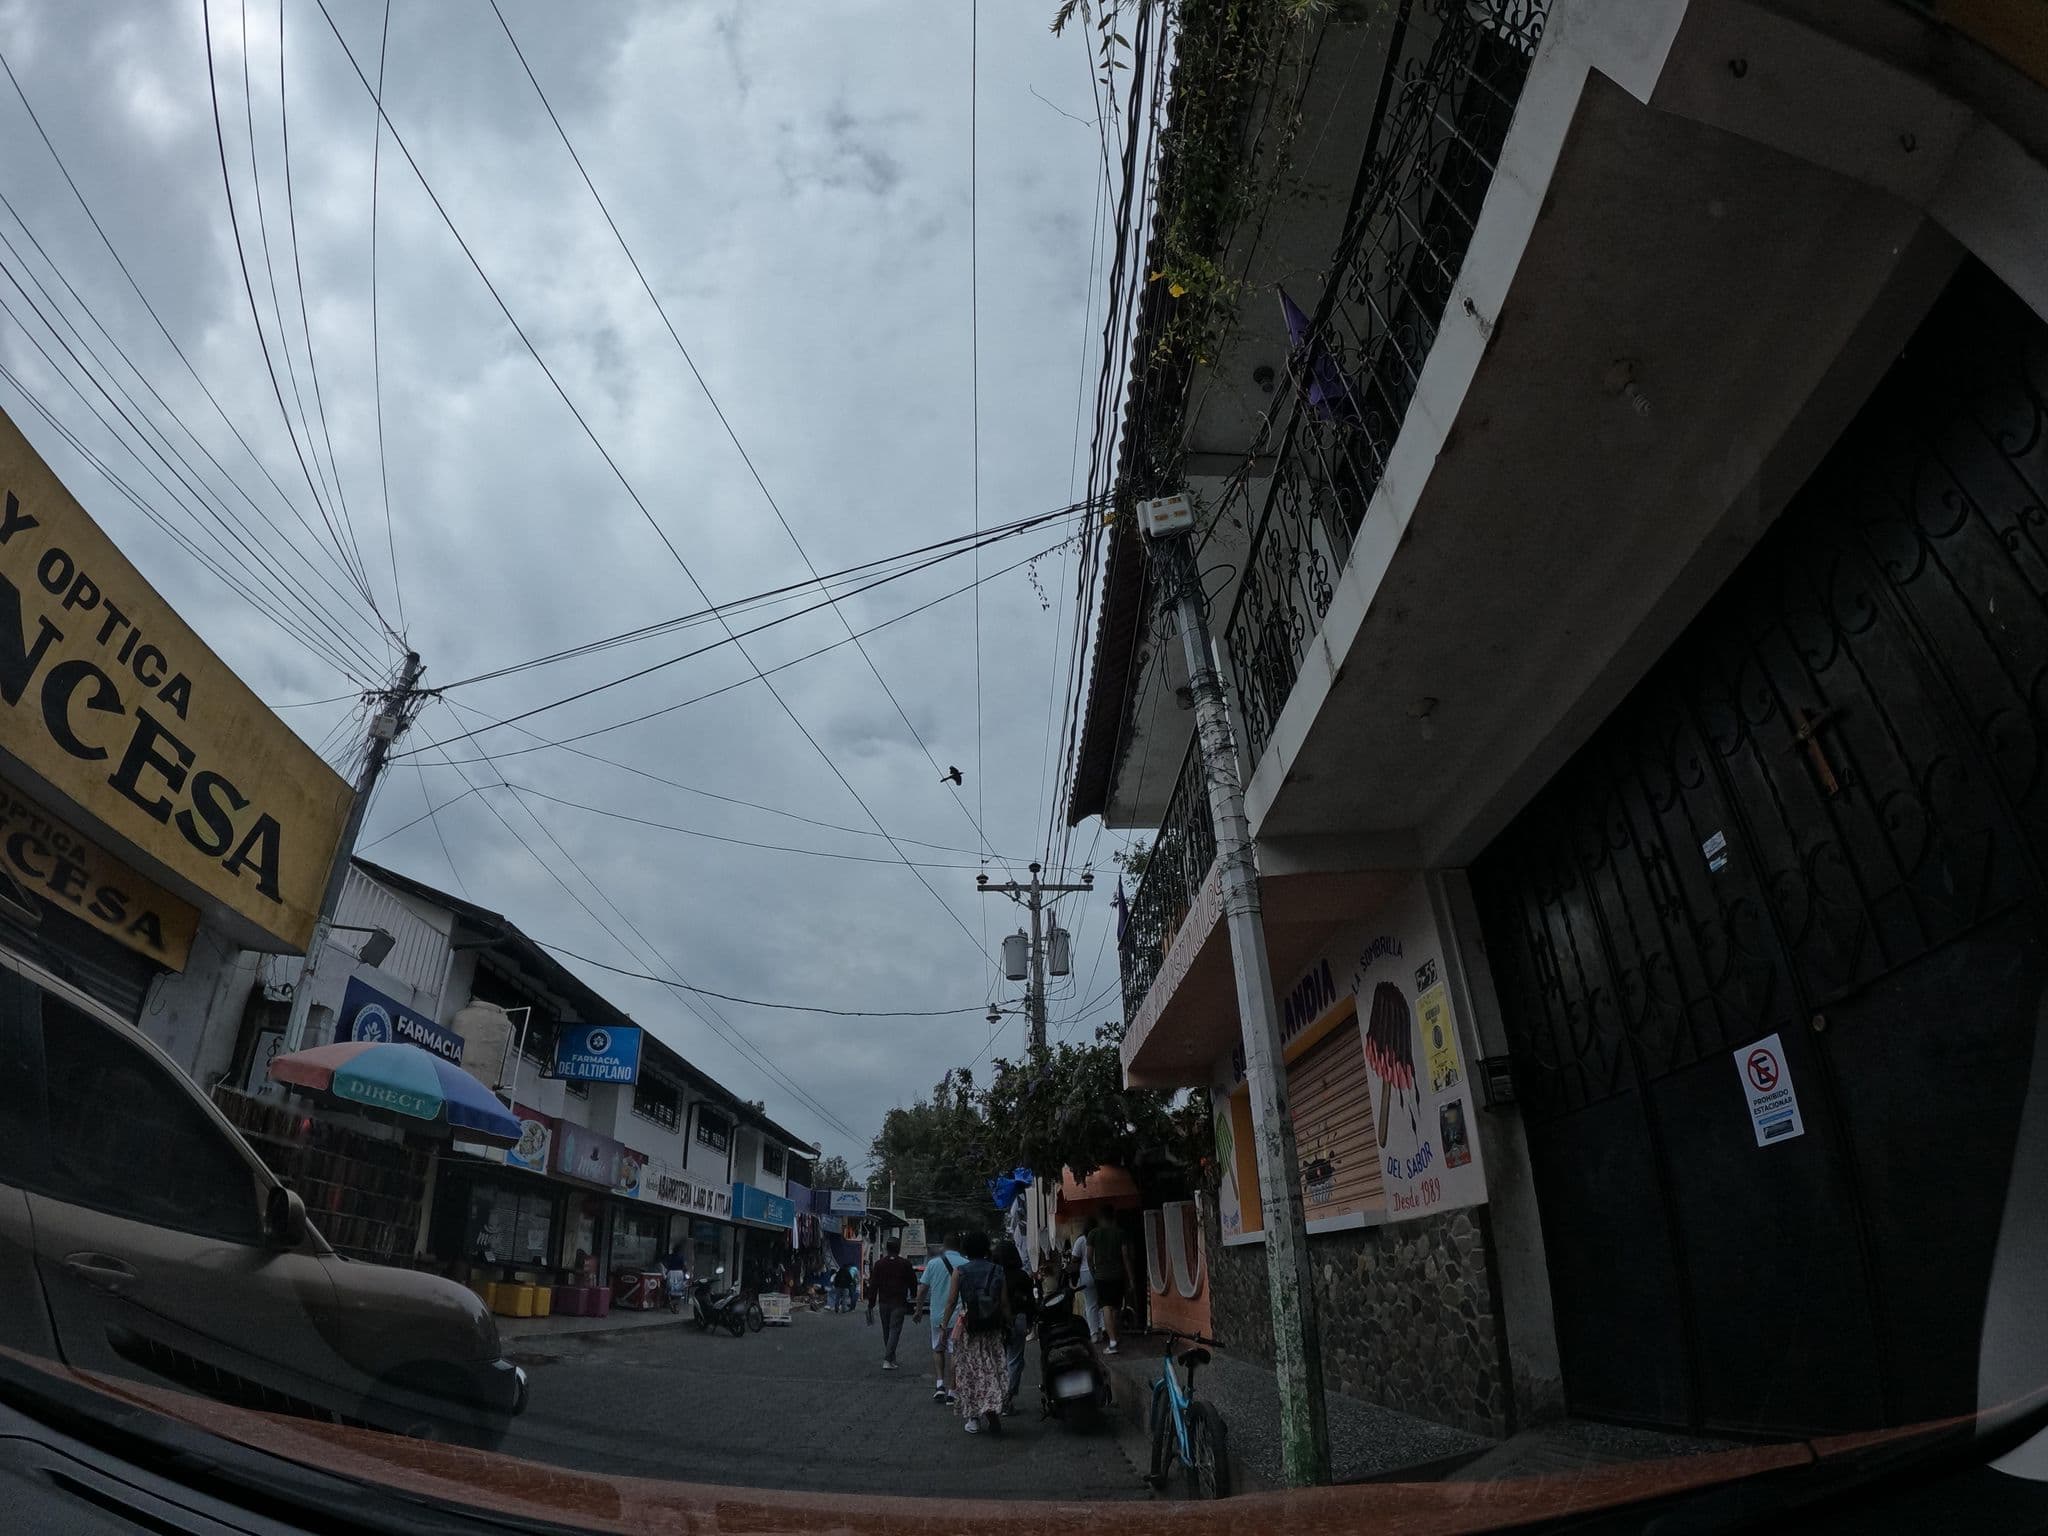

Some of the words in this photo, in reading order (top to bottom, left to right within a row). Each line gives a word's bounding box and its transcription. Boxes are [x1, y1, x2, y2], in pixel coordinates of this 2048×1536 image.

[37, 548, 193, 720] OPTICA
[0, 820, 166, 951] CESA
[1360, 936, 1403, 972] SOMBRILLA
[396, 1016, 464, 1062] FARMACIA
[558, 1061, 576, 1076] DEL
[577, 1062, 632, 1080] ALTIPLANO
[571, 1054, 620, 1065] FARMACIA
[1753, 1088, 1789, 1106] PROHIBIDO
[1753, 1096, 1793, 1115] ESTACIONAR
[1387, 1156, 1403, 1179] DEL
[1406, 1141, 1433, 1179] SABOR
[1393, 1185, 1420, 1212] Desde
[1420, 1177, 1441, 1206] 1989
